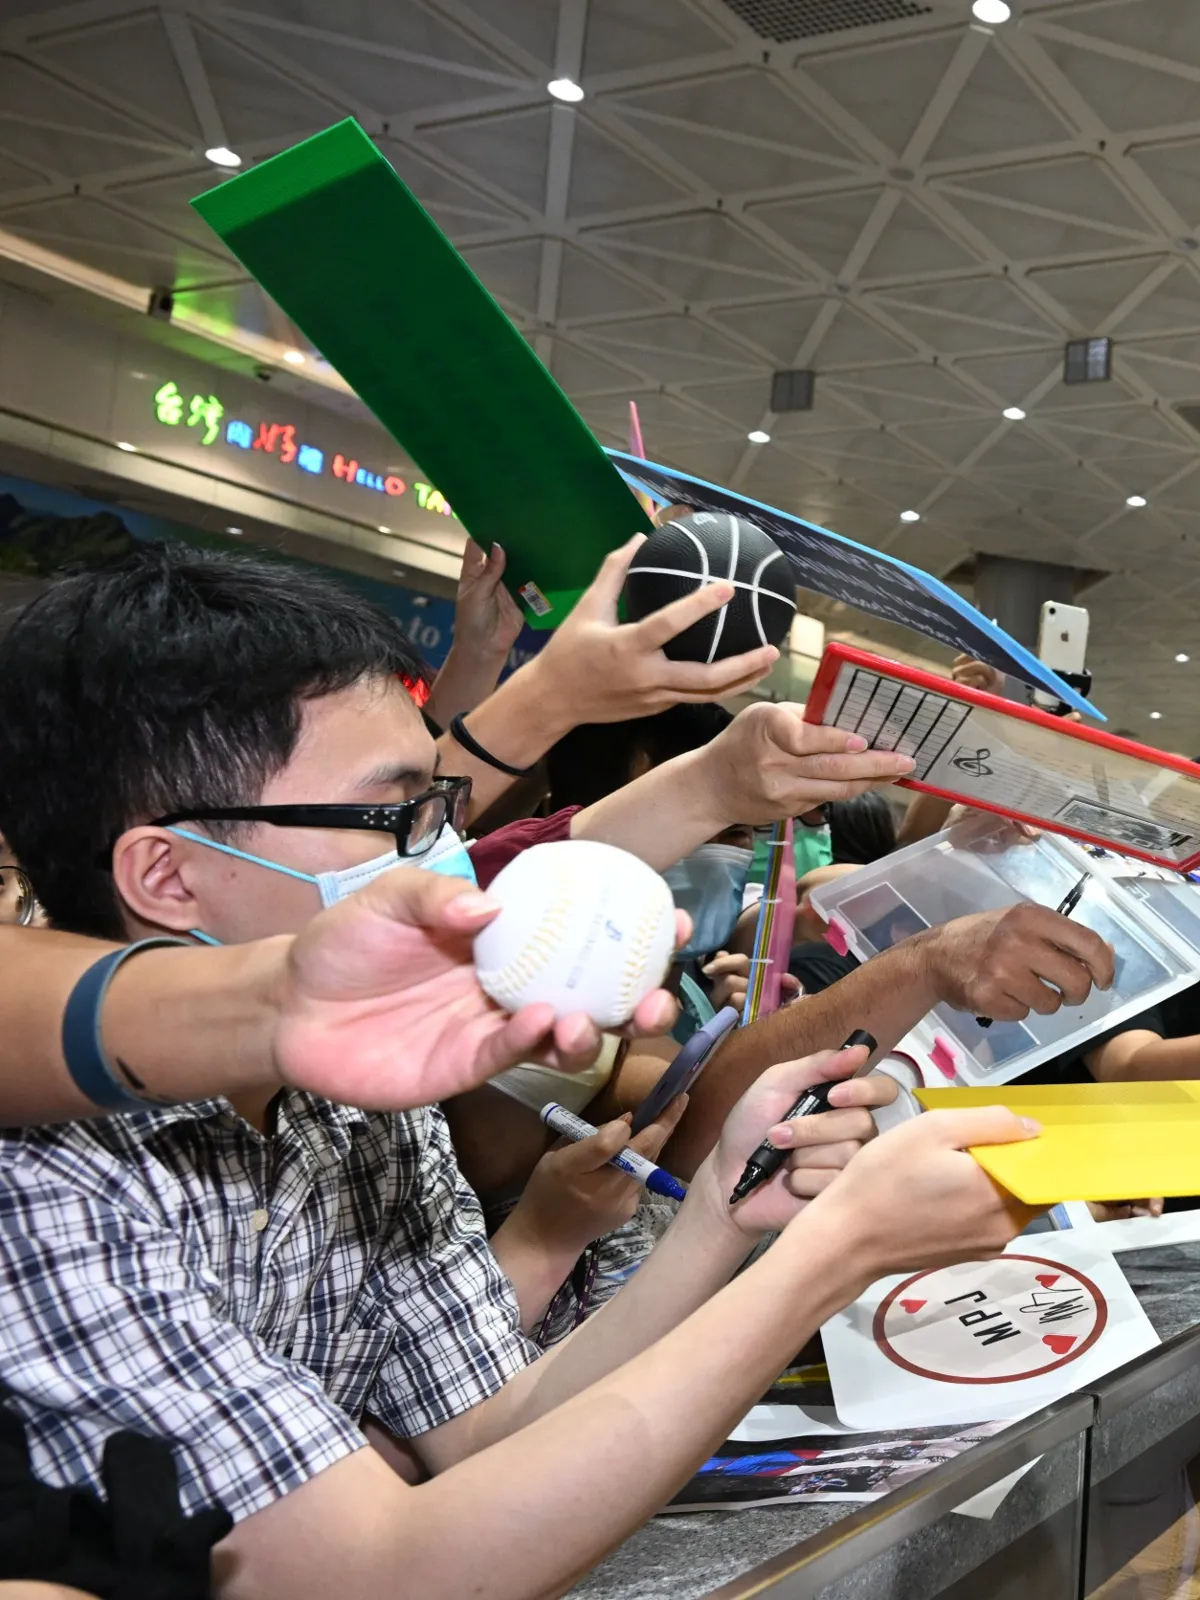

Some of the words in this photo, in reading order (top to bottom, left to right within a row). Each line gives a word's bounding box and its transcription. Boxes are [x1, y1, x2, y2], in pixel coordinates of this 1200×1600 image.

[332, 454, 406, 496] HELLO
[413, 482, 458, 520] TAI
[407, 615, 441, 649] to
[944, 1290, 1021, 1346] MPJ
